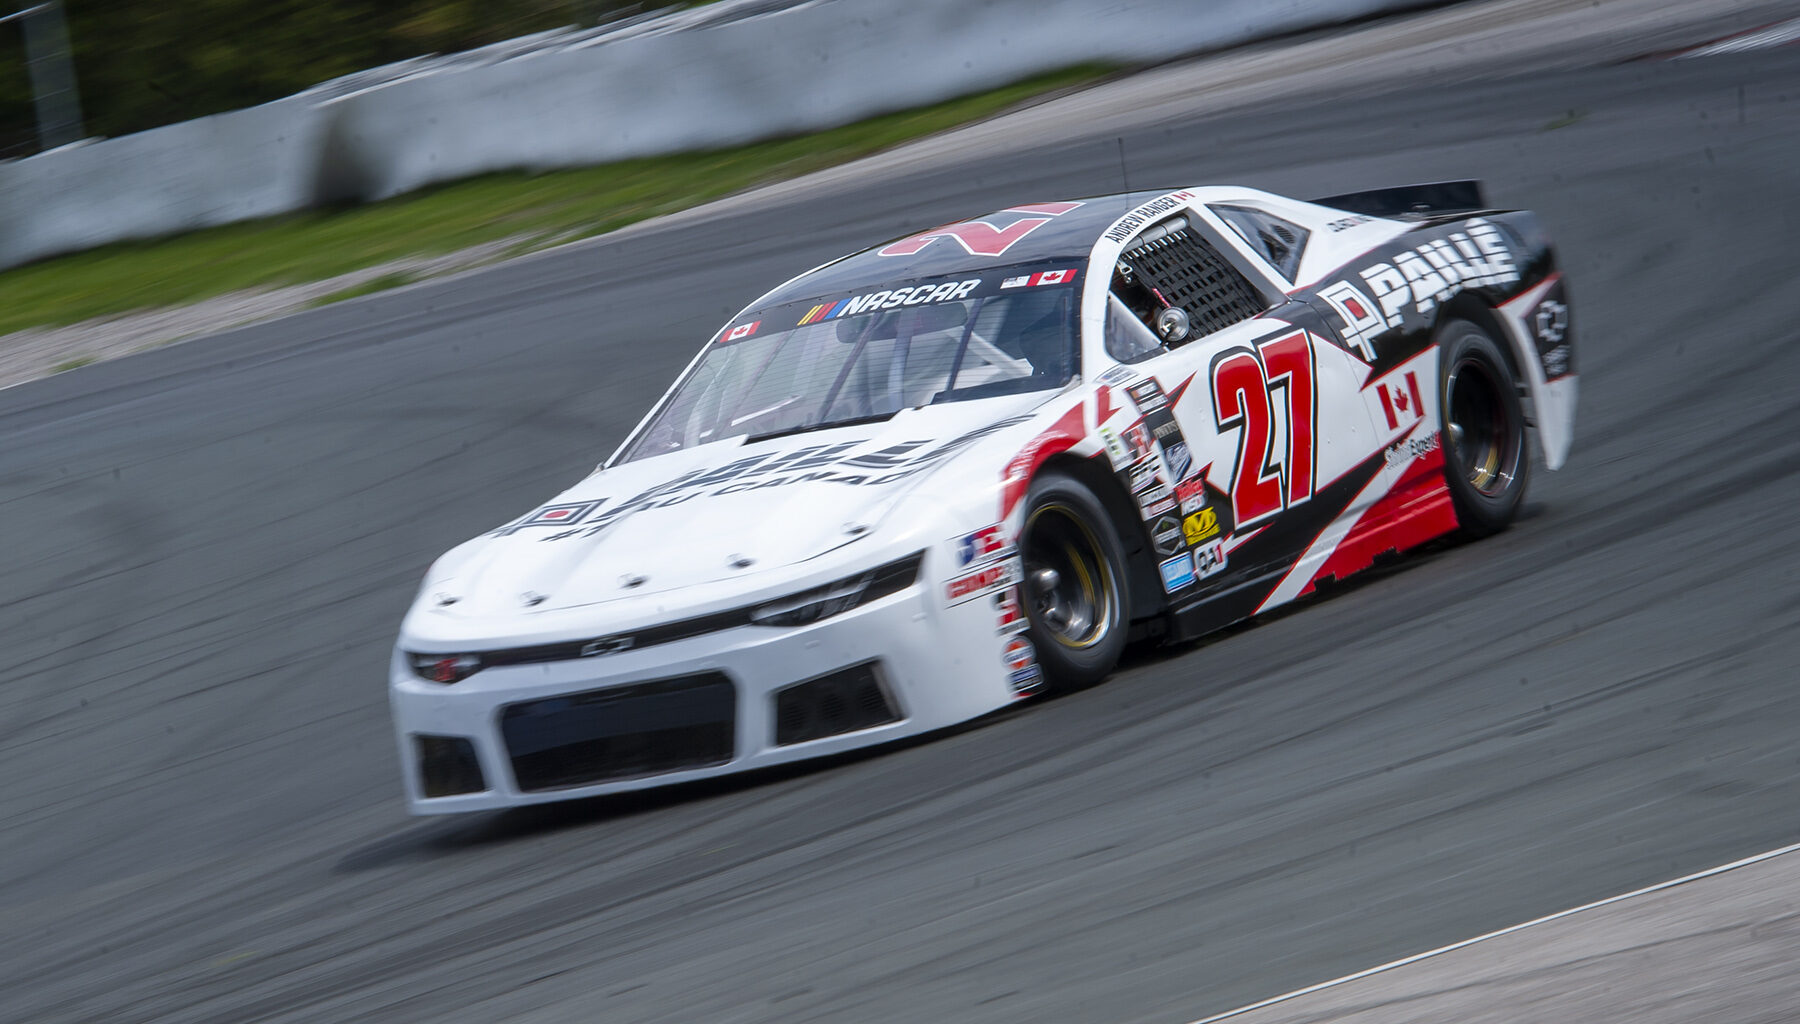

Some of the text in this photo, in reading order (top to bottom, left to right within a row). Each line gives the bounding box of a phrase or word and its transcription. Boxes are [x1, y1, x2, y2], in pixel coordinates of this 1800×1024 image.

[1105, 196, 1181, 244] ANDREW RANGER
[837, 279, 982, 318] NASCAR
[1209, 327, 1319, 530] 27
